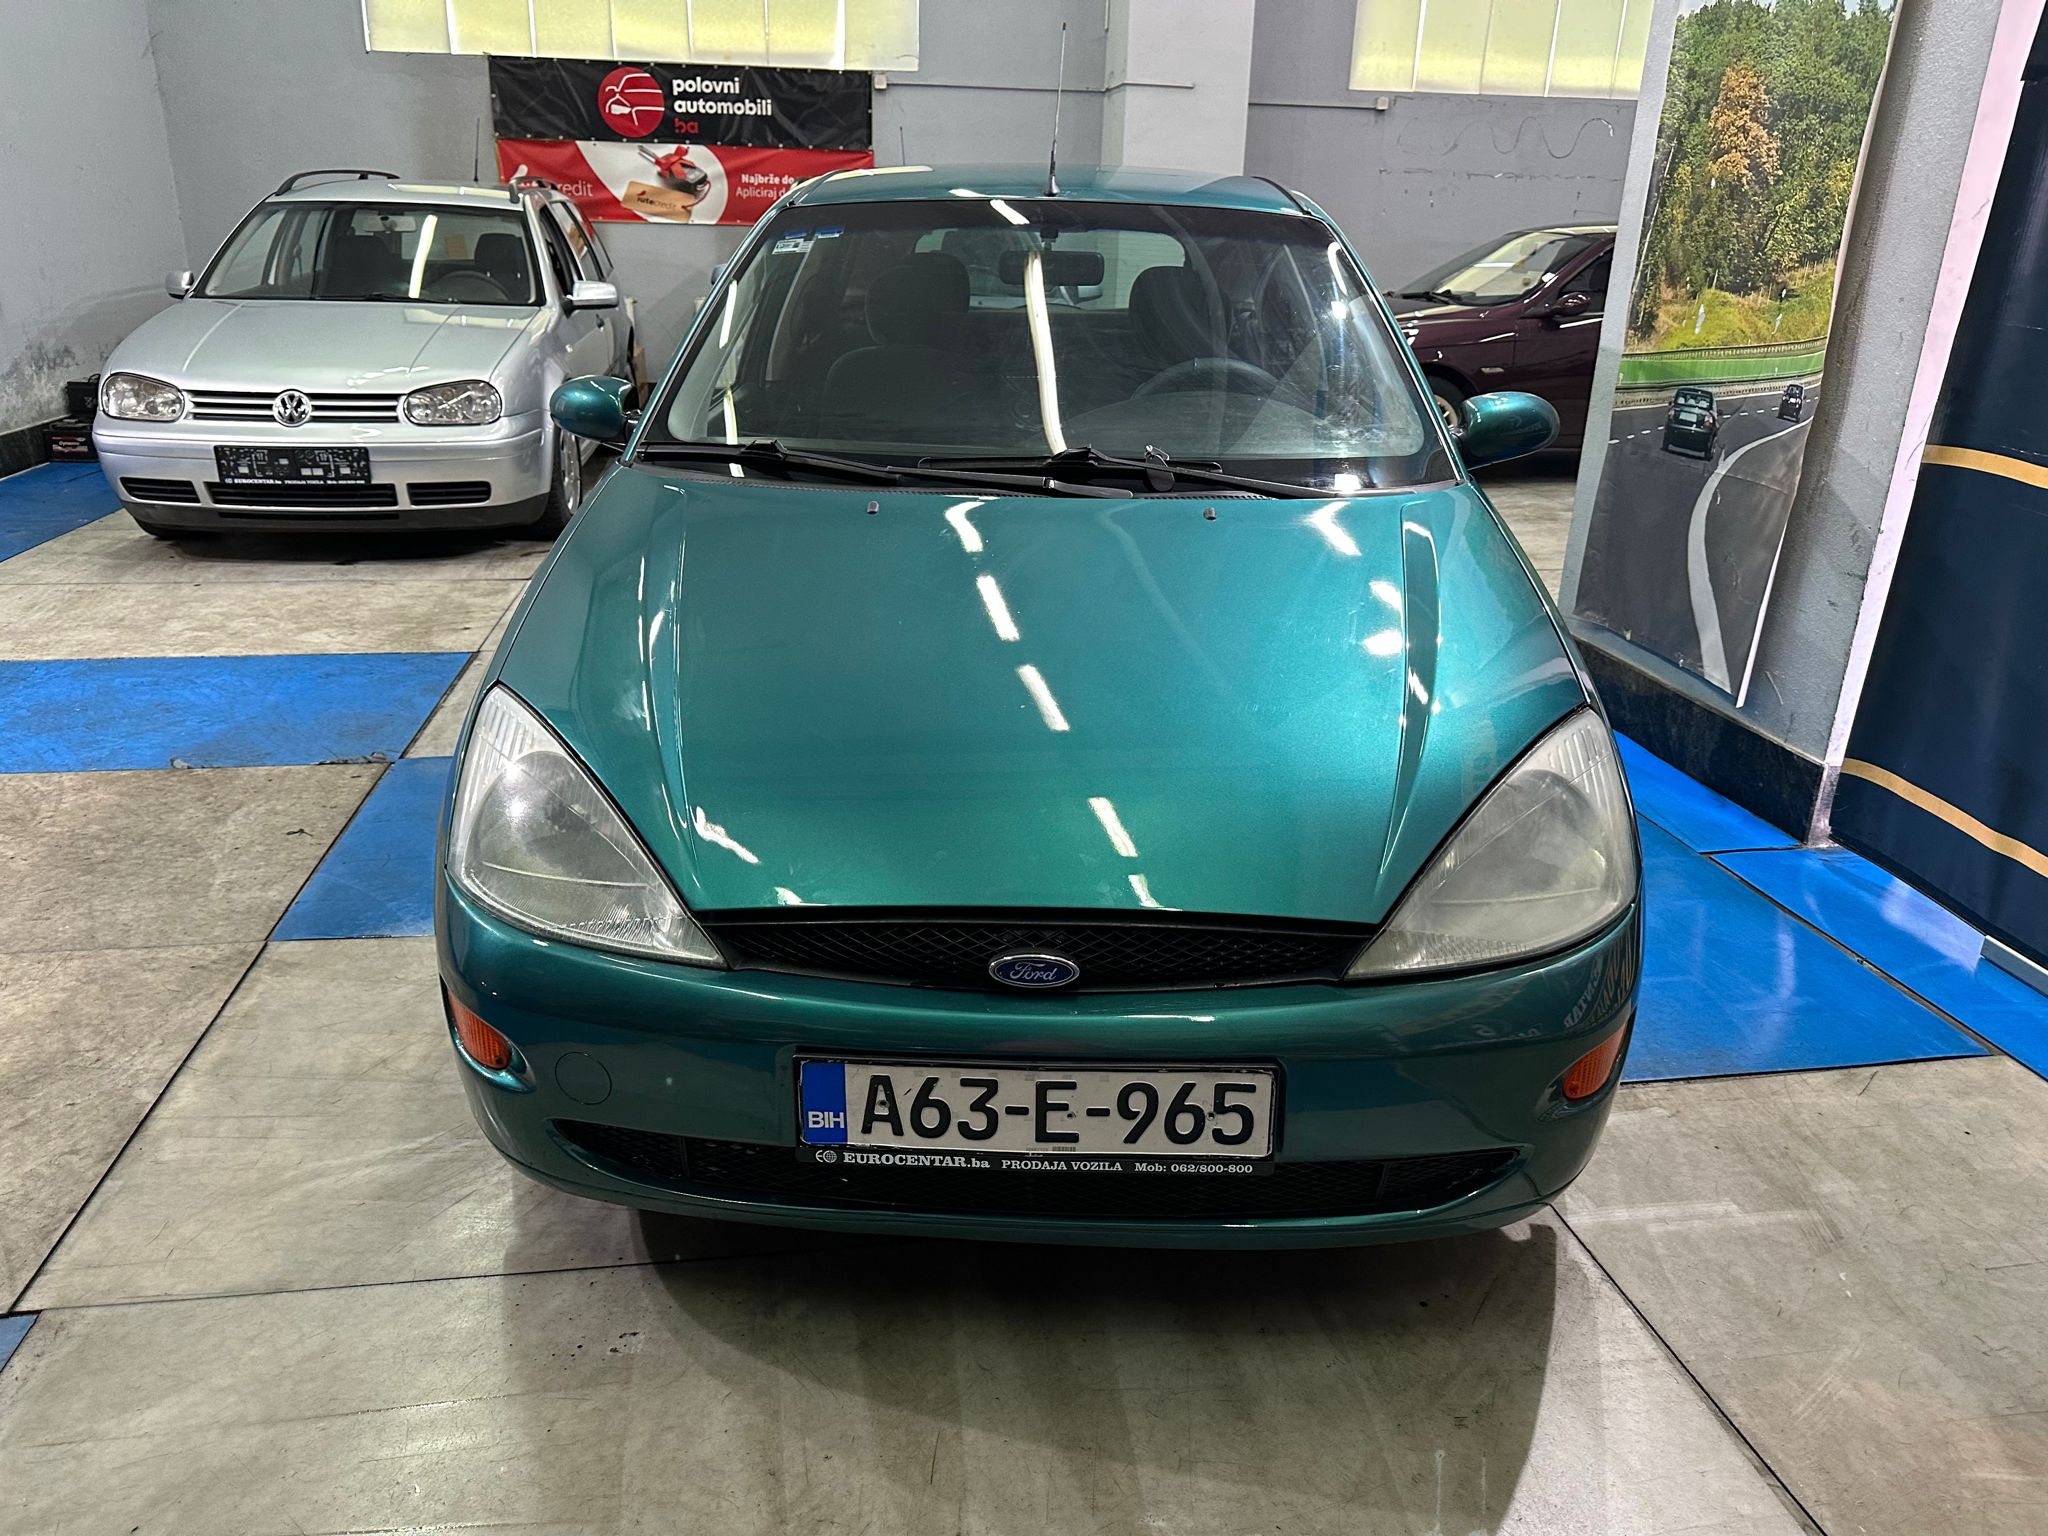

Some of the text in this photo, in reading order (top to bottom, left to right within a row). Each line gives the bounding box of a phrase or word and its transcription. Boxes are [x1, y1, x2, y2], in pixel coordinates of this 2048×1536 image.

[672, 76, 740, 96] polovni
[673, 98, 772, 116] automobili
[741, 173, 780, 186] Najbrže
[735, 186, 777, 200] Apliciraj
[1009, 961, 1058, 980] Ford
[807, 1110, 845, 1129] BIH
[861, 1074, 1258, 1146] A63-E-965
[843, 1151, 990, 1169] EUROCENTAR.ba
[1001, 1159, 1067, 1171] PRODAJA
[1071, 1161, 1123, 1171] VOZILA
[1134, 1162, 1167, 1173] Mob:
[1170, 1163, 1253, 1174] 062/800-800
